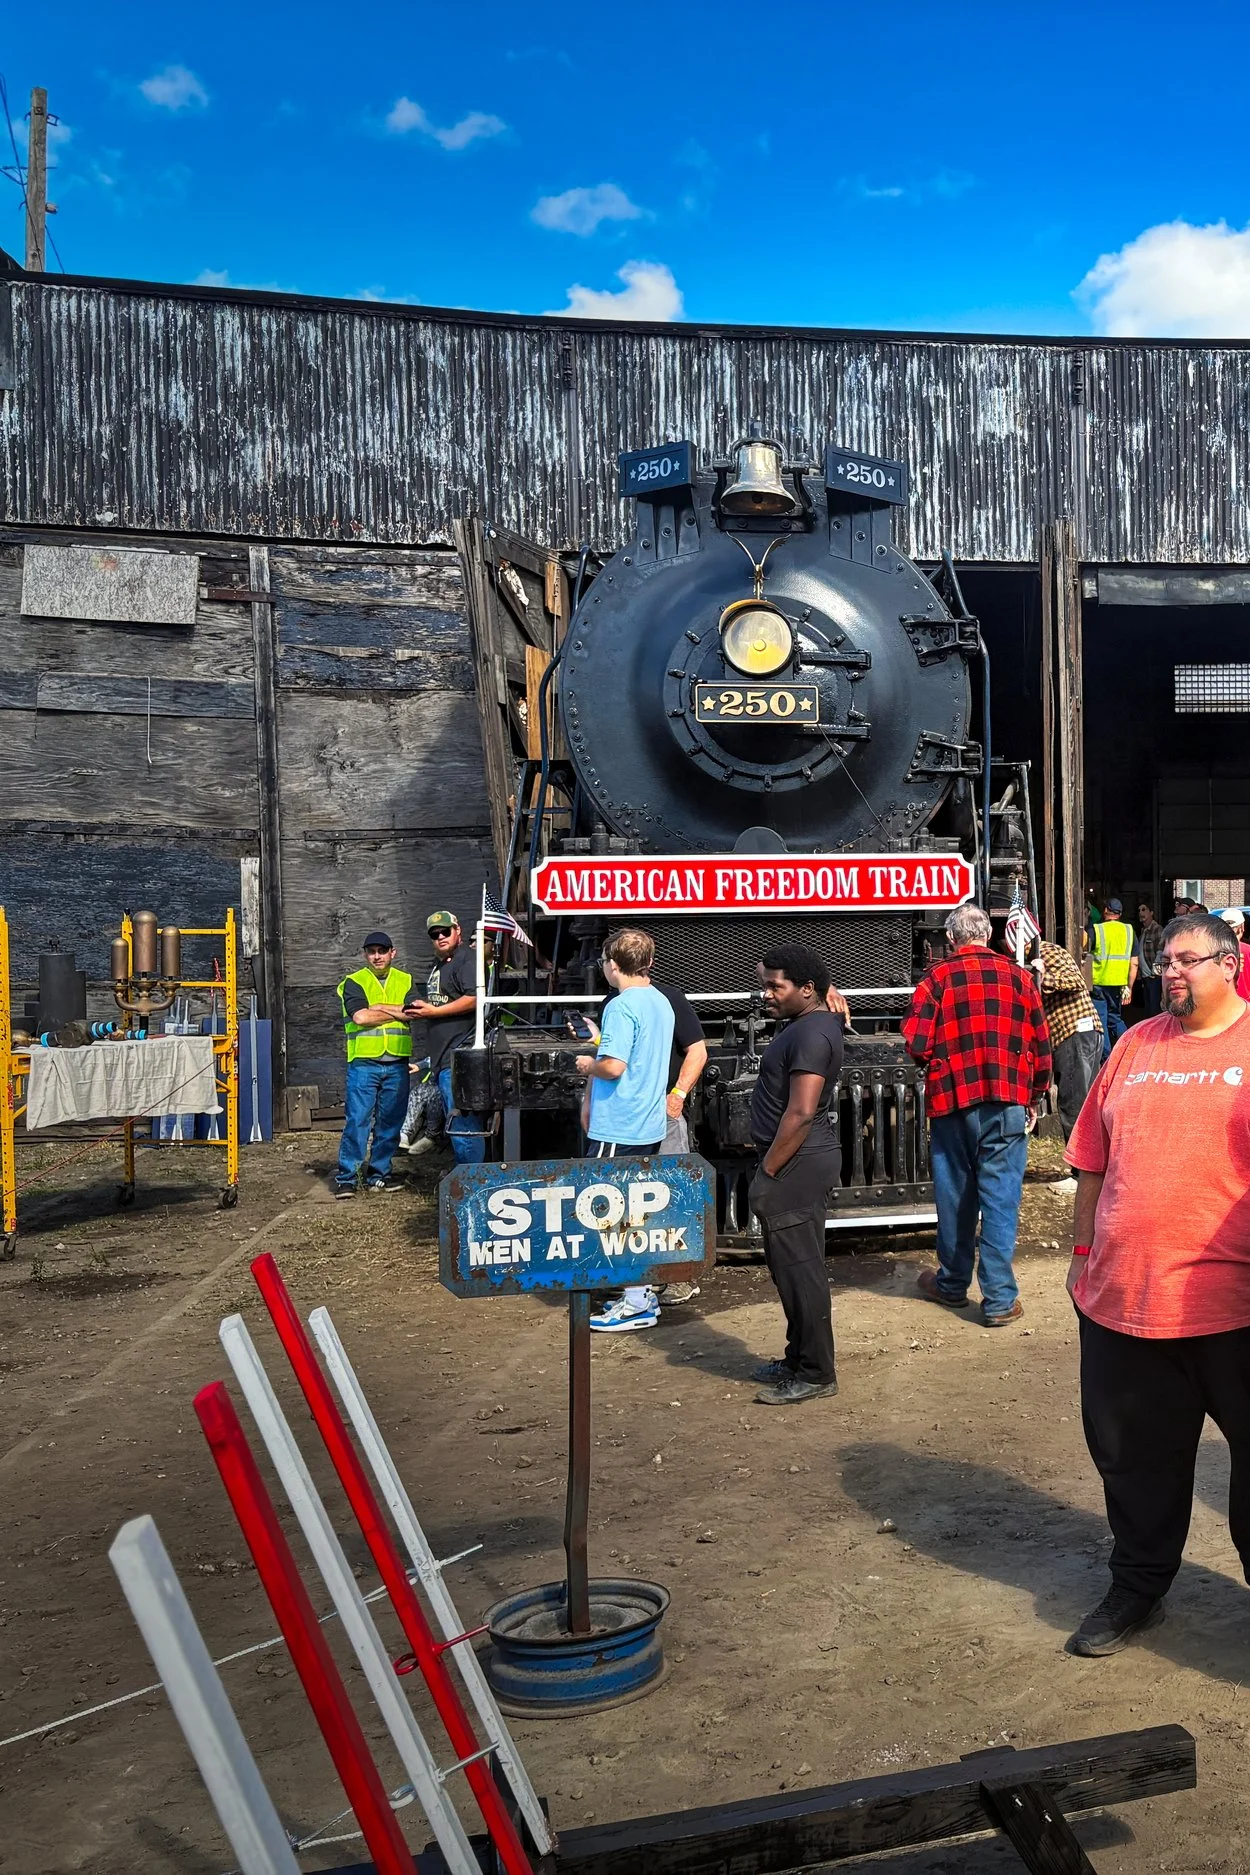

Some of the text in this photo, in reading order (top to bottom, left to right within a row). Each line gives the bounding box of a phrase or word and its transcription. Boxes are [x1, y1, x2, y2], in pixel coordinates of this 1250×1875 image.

[637, 456, 672, 482] 250
[846, 462, 886, 488] 250
[719, 690, 796, 717] 250
[544, 865, 961, 902] AMERICAN FREEDOM TRAIN
[1124, 1068, 1219, 1086] carhartt
[487, 1181, 671, 1237] STOP
[469, 1227, 688, 1267] MEN AT WORK
